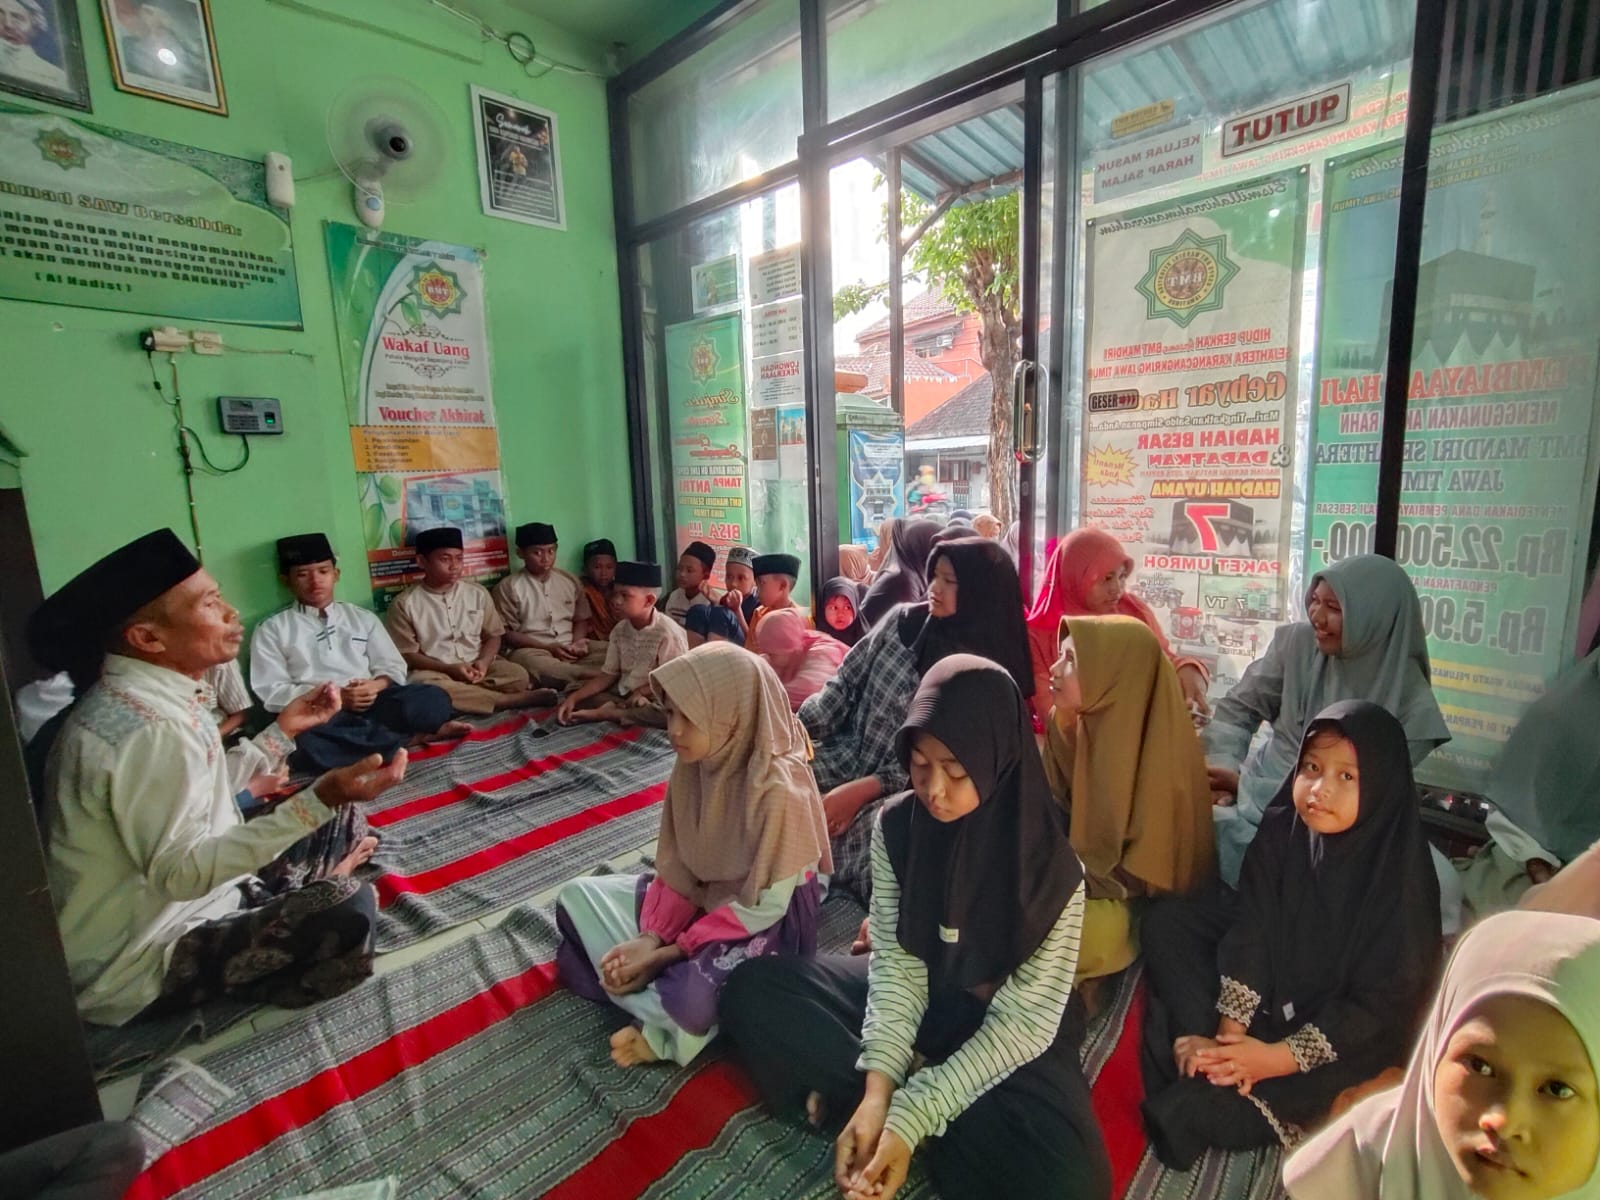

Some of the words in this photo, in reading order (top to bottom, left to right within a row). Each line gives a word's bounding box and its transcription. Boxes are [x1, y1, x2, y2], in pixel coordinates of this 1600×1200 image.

[1232, 93, 1340, 148] TUTUP
[77, 194, 129, 216] SAW
[4, 222, 99, 247] membantu
[53, 217, 118, 238] dengan
[121, 230, 153, 244] niat
[13, 249, 57, 263] akan
[54, 243, 89, 257] niat
[382, 336, 429, 353] Wakaf
[433, 342, 470, 360] Uang
[1092, 393, 1118, 409] GESER
[378, 406, 436, 423] Voucher
